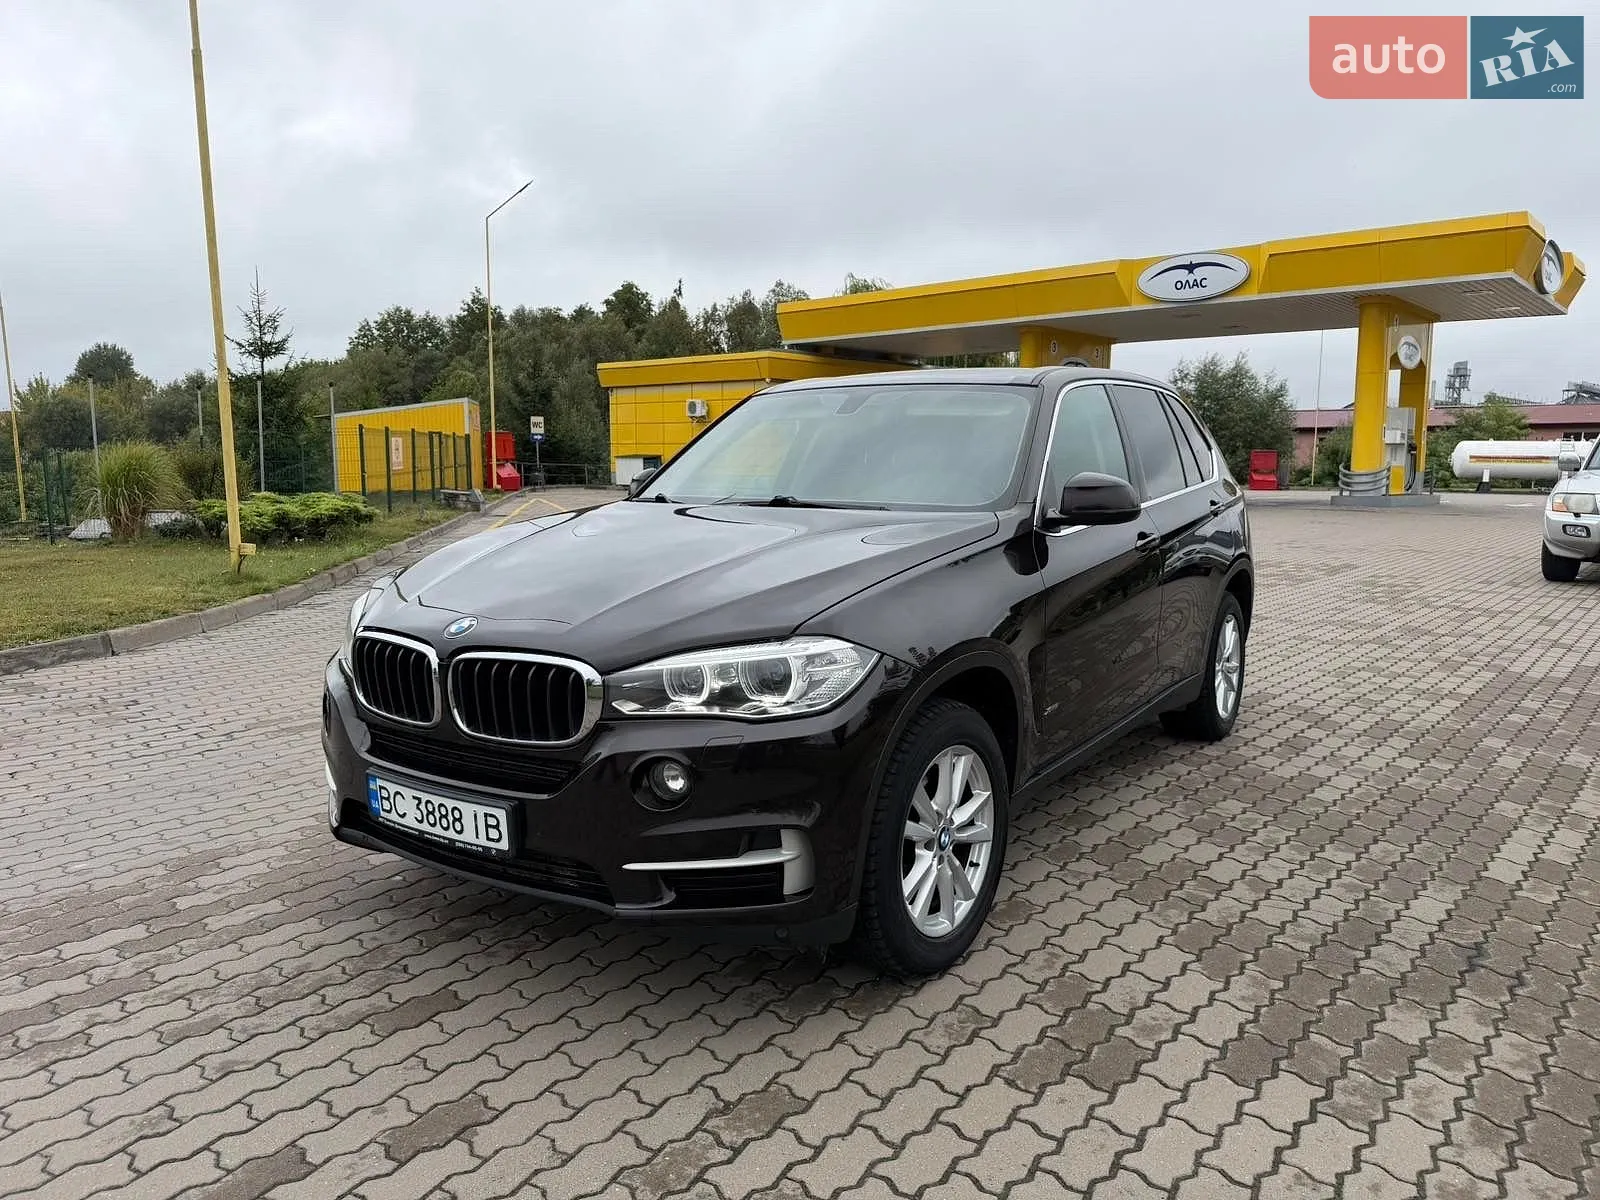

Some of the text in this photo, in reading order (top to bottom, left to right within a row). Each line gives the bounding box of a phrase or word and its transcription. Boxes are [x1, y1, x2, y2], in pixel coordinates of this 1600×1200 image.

[1174, 277, 1208, 291] ОЛАС
[532, 421, 543, 429] WC
[378, 784, 408, 819] BC
[411, 795, 465, 836] 3888
[472, 809, 503, 843] IB
